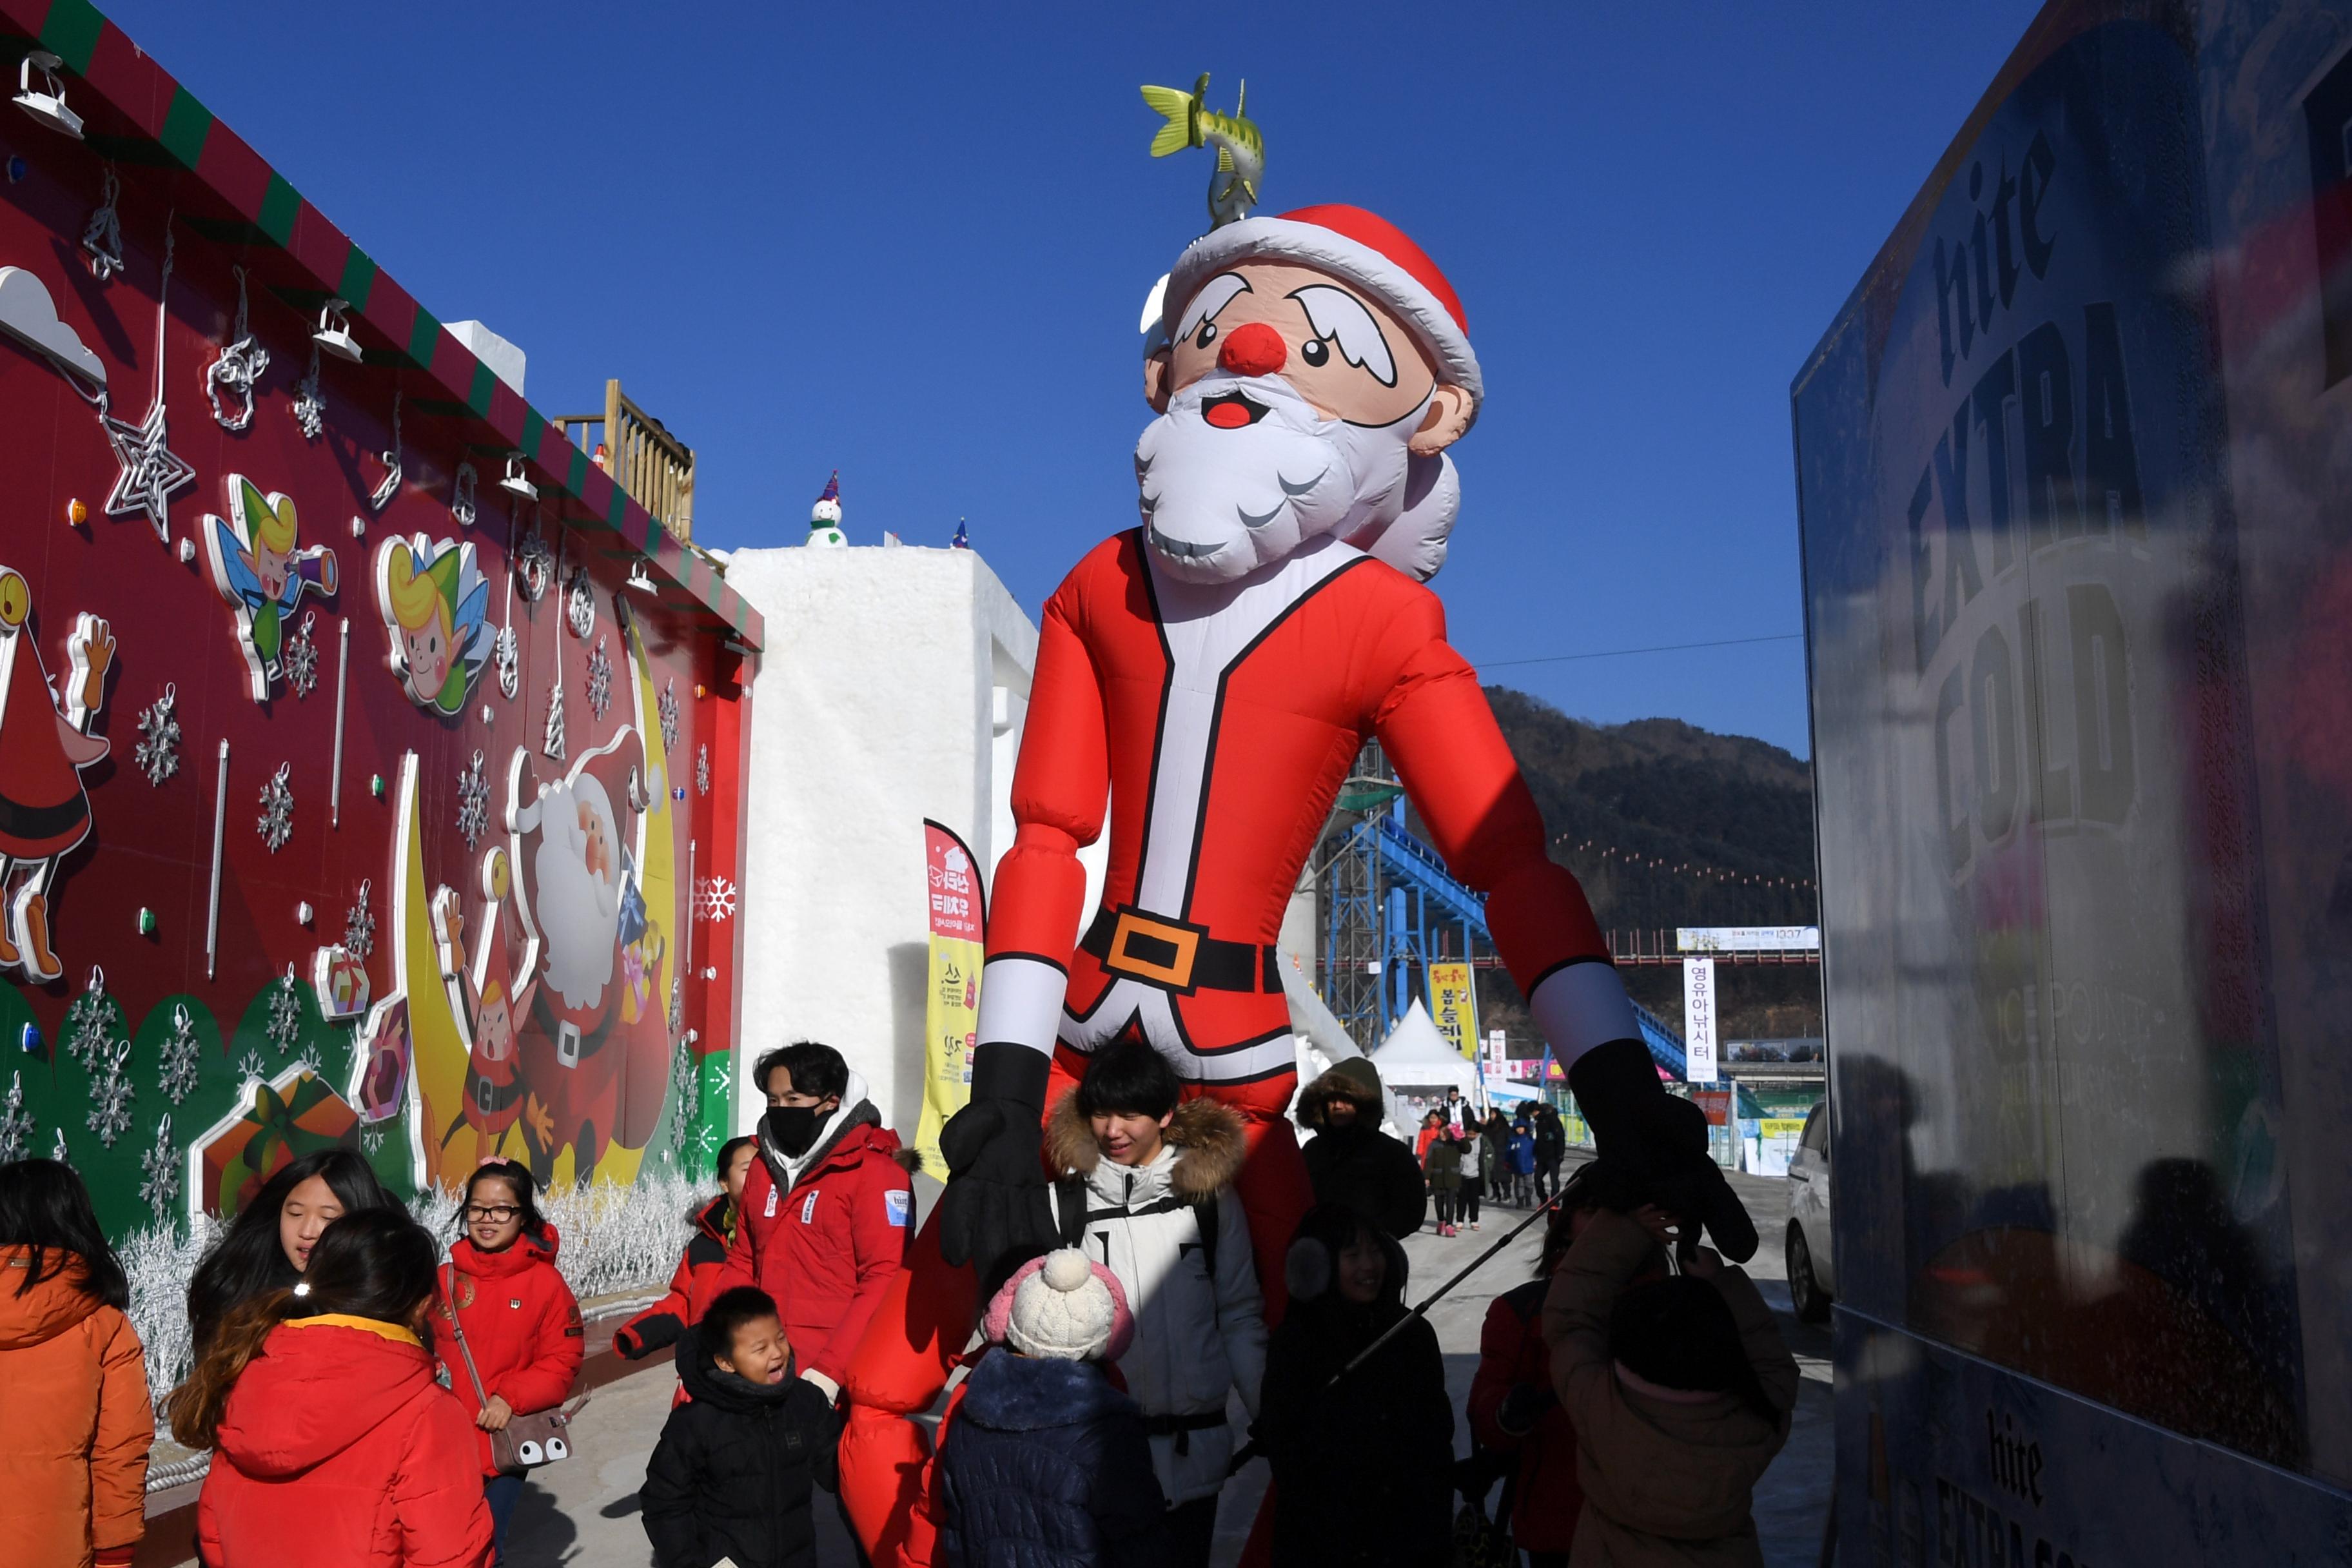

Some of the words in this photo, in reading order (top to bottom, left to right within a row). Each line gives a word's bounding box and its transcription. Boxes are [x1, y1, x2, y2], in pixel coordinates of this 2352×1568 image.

[1932, 128, 2058, 389] hite
[1908, 300, 2151, 689] EXTRA
[1936, 582, 2137, 881] COLD
[1691, 966, 1709, 1061] 영유아낚시터
[1996, 984, 2038, 1049] ICE
[2048, 978, 2148, 1052] POINT
[1986, 1407, 2043, 1507] hite
